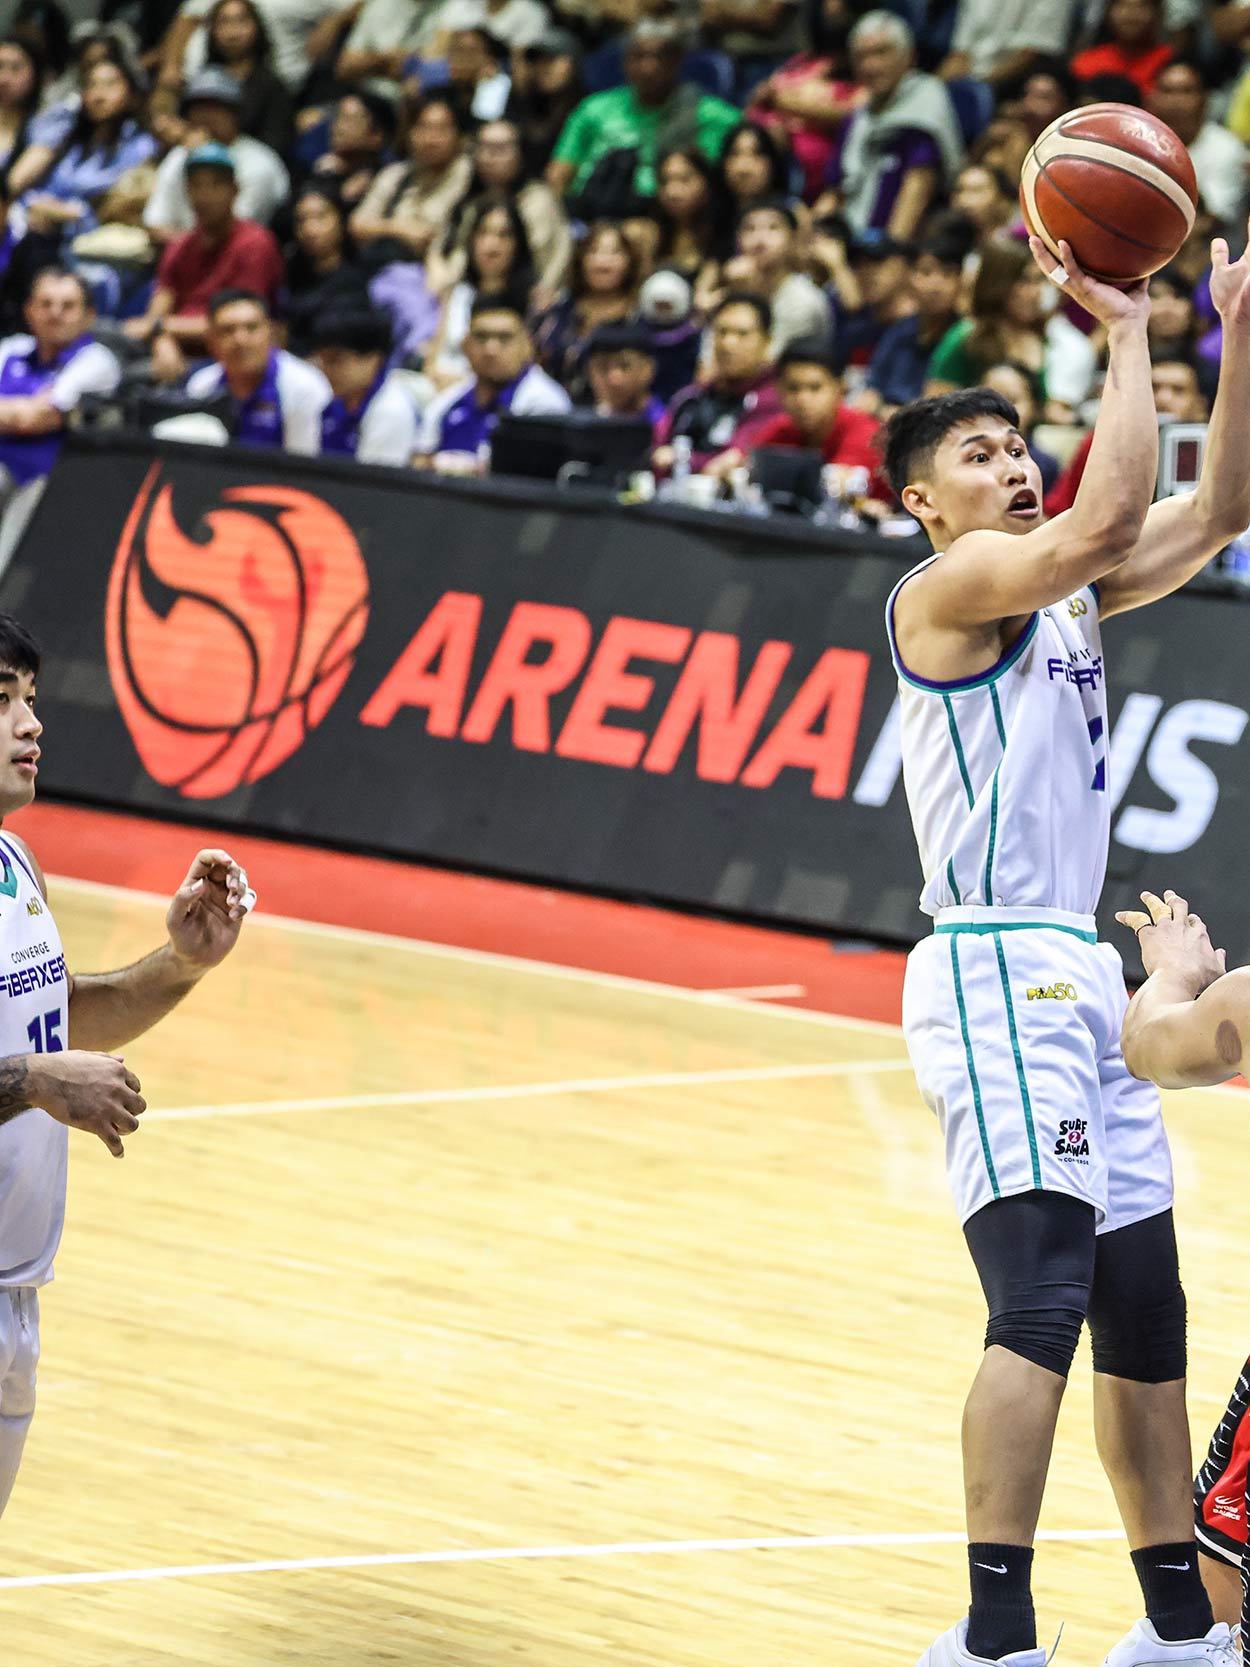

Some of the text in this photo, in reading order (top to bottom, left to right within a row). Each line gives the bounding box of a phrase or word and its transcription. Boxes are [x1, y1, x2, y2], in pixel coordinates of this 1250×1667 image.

[11, 941, 50, 964] CONVERGE
[1059, 1118, 1088, 1136] SURF
[1069, 1131, 1080, 1143] 2
[1054, 1138, 1090, 1157] SAWA
